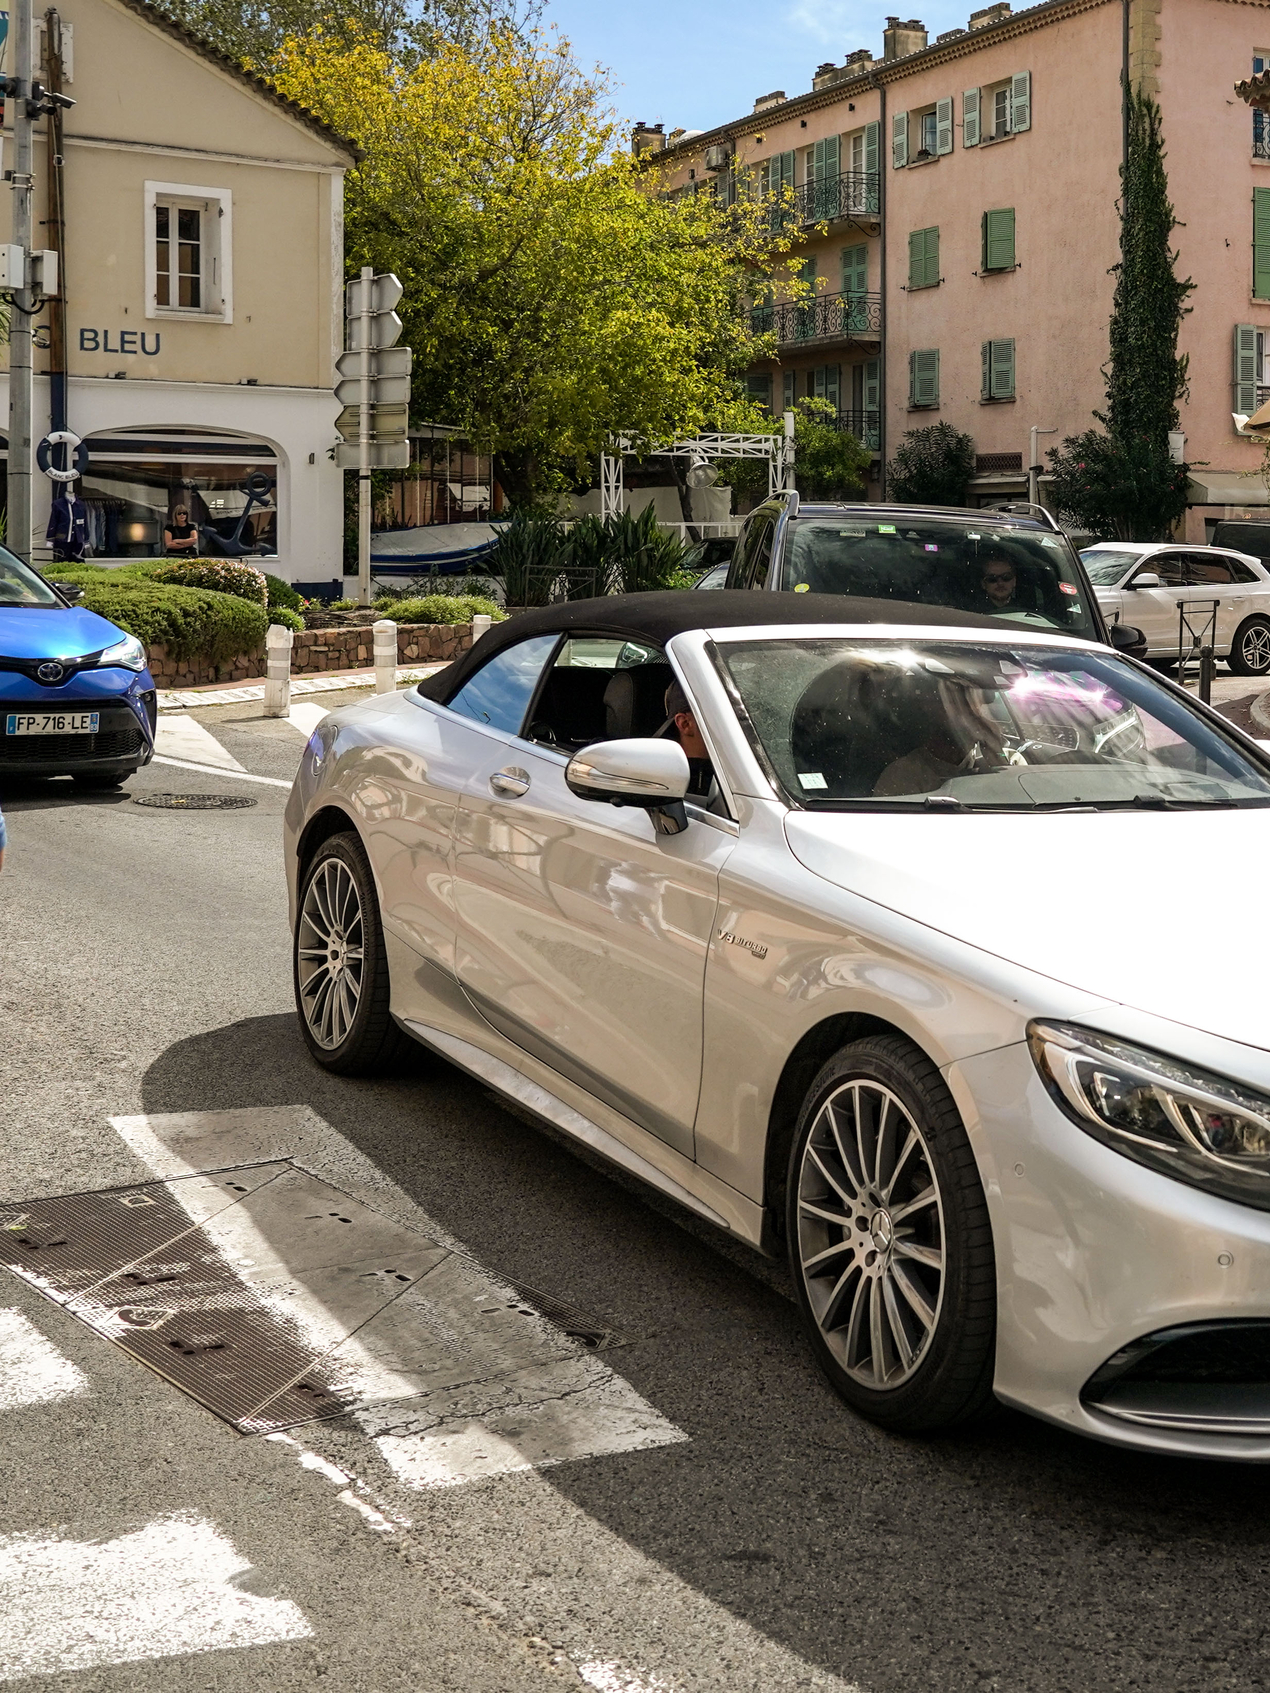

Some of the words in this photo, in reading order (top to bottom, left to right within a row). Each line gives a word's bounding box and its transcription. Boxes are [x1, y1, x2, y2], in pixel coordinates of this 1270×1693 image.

[79, 327, 161, 356] BLEU
[17, 715, 89, 731] FP-716-LE
[717, 929, 736, 944] V8
[736, 937, 768, 955] BITURBO
